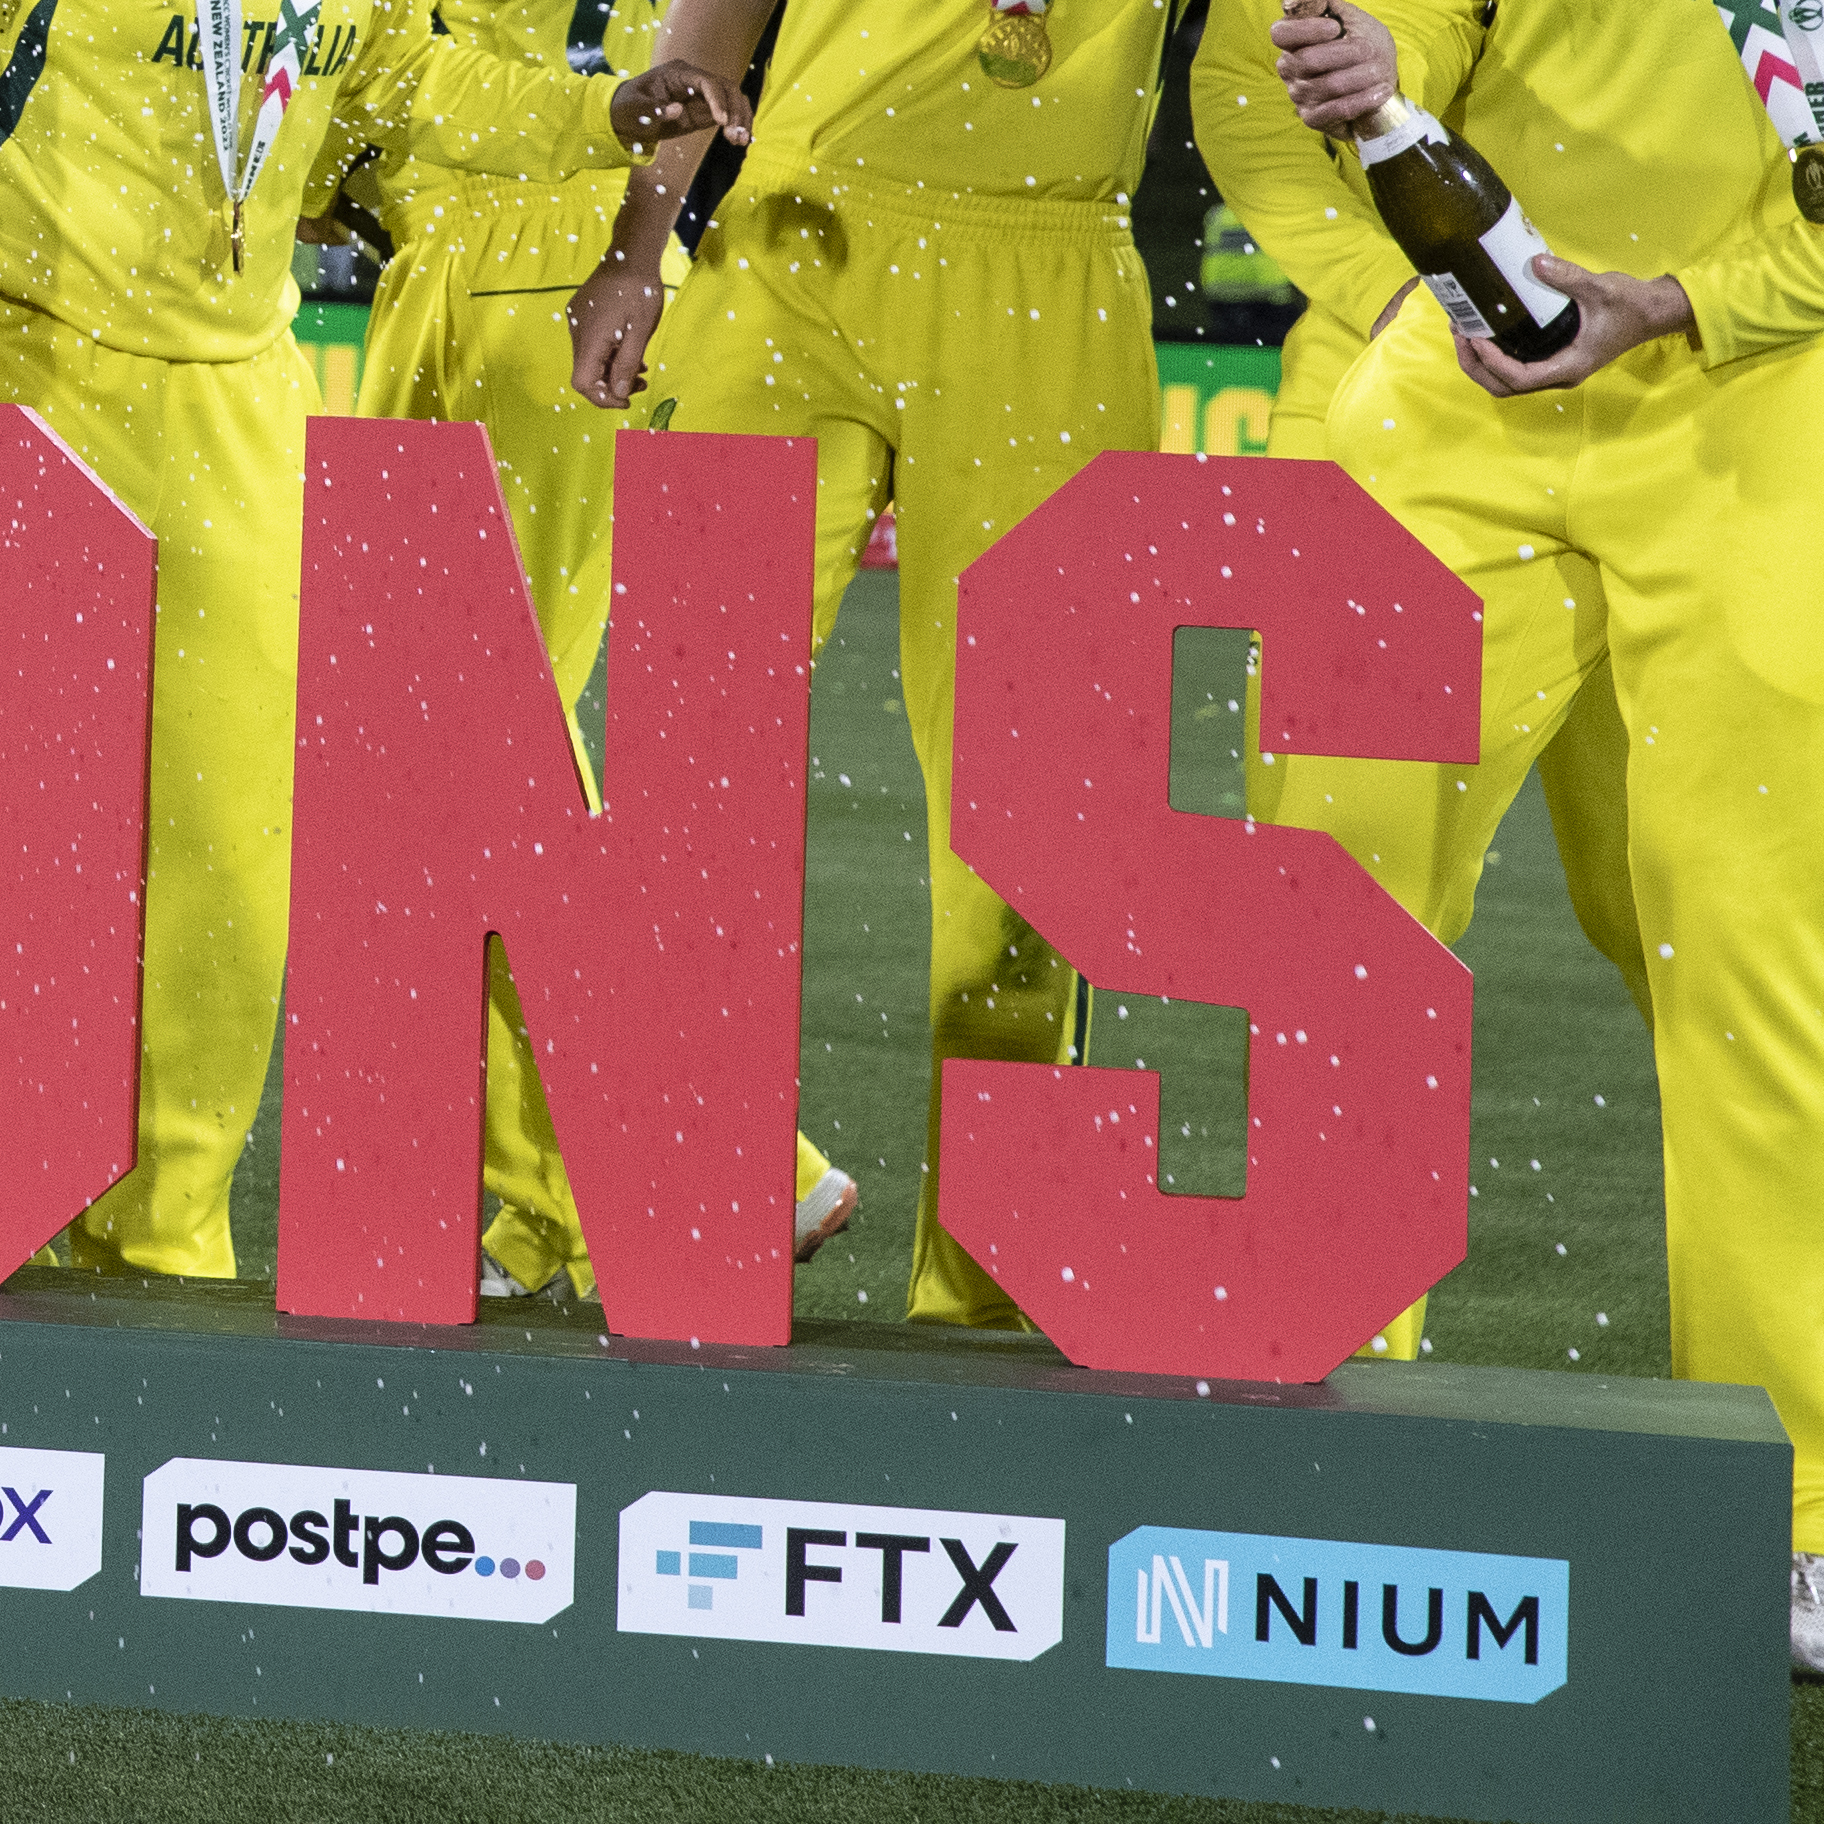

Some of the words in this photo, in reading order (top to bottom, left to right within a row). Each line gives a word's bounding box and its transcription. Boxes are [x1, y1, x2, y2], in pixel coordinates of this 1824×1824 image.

[209, 0, 223, 37] NEW
[212, 40, 227, 113] ZEALAND
[784, 1526, 1020, 1632] FTX
[1254, 1572, 1541, 1666] NIUM
